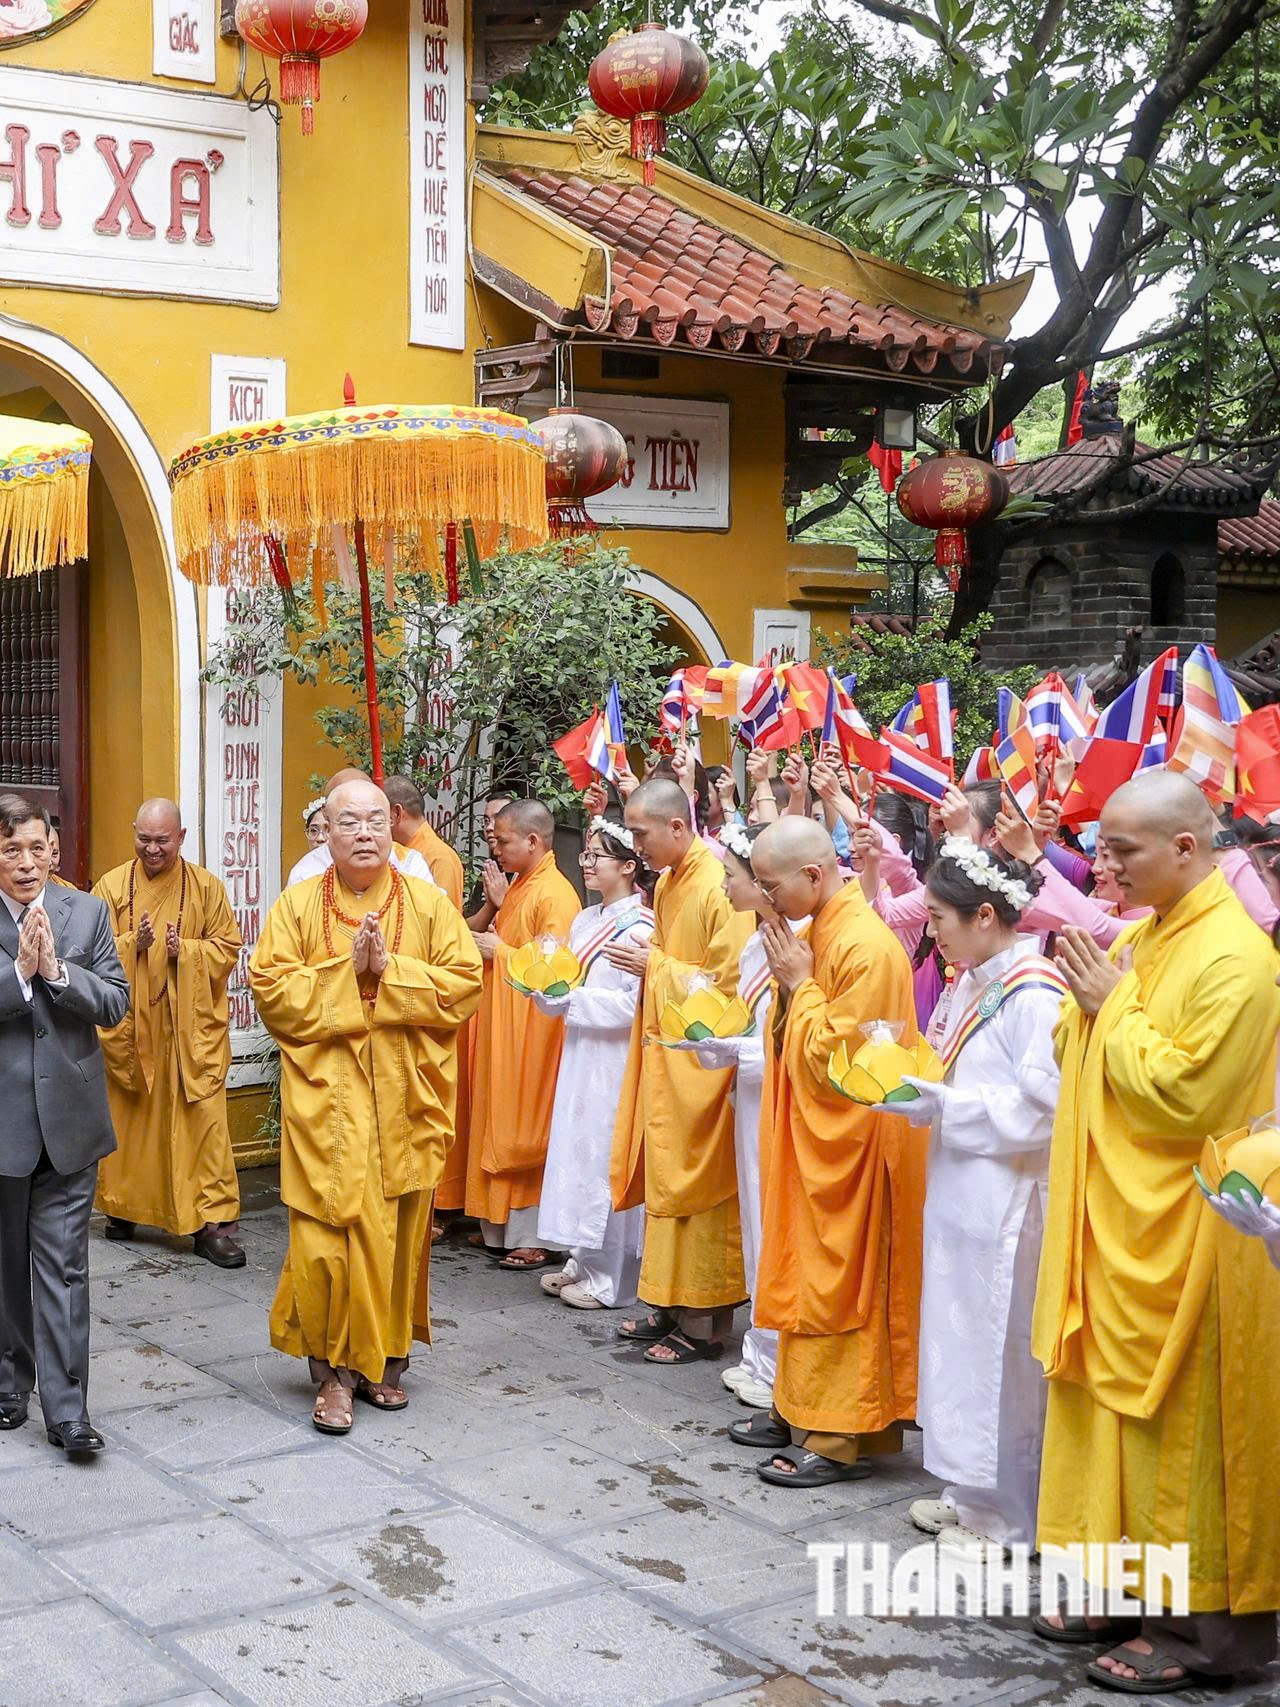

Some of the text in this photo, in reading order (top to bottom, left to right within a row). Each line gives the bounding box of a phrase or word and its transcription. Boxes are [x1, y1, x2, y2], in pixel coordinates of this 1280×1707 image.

[424, 30, 448, 75] GIÁC
[424, 83, 446, 128] NGỘ
[644, 430, 699, 499] TIỆN
